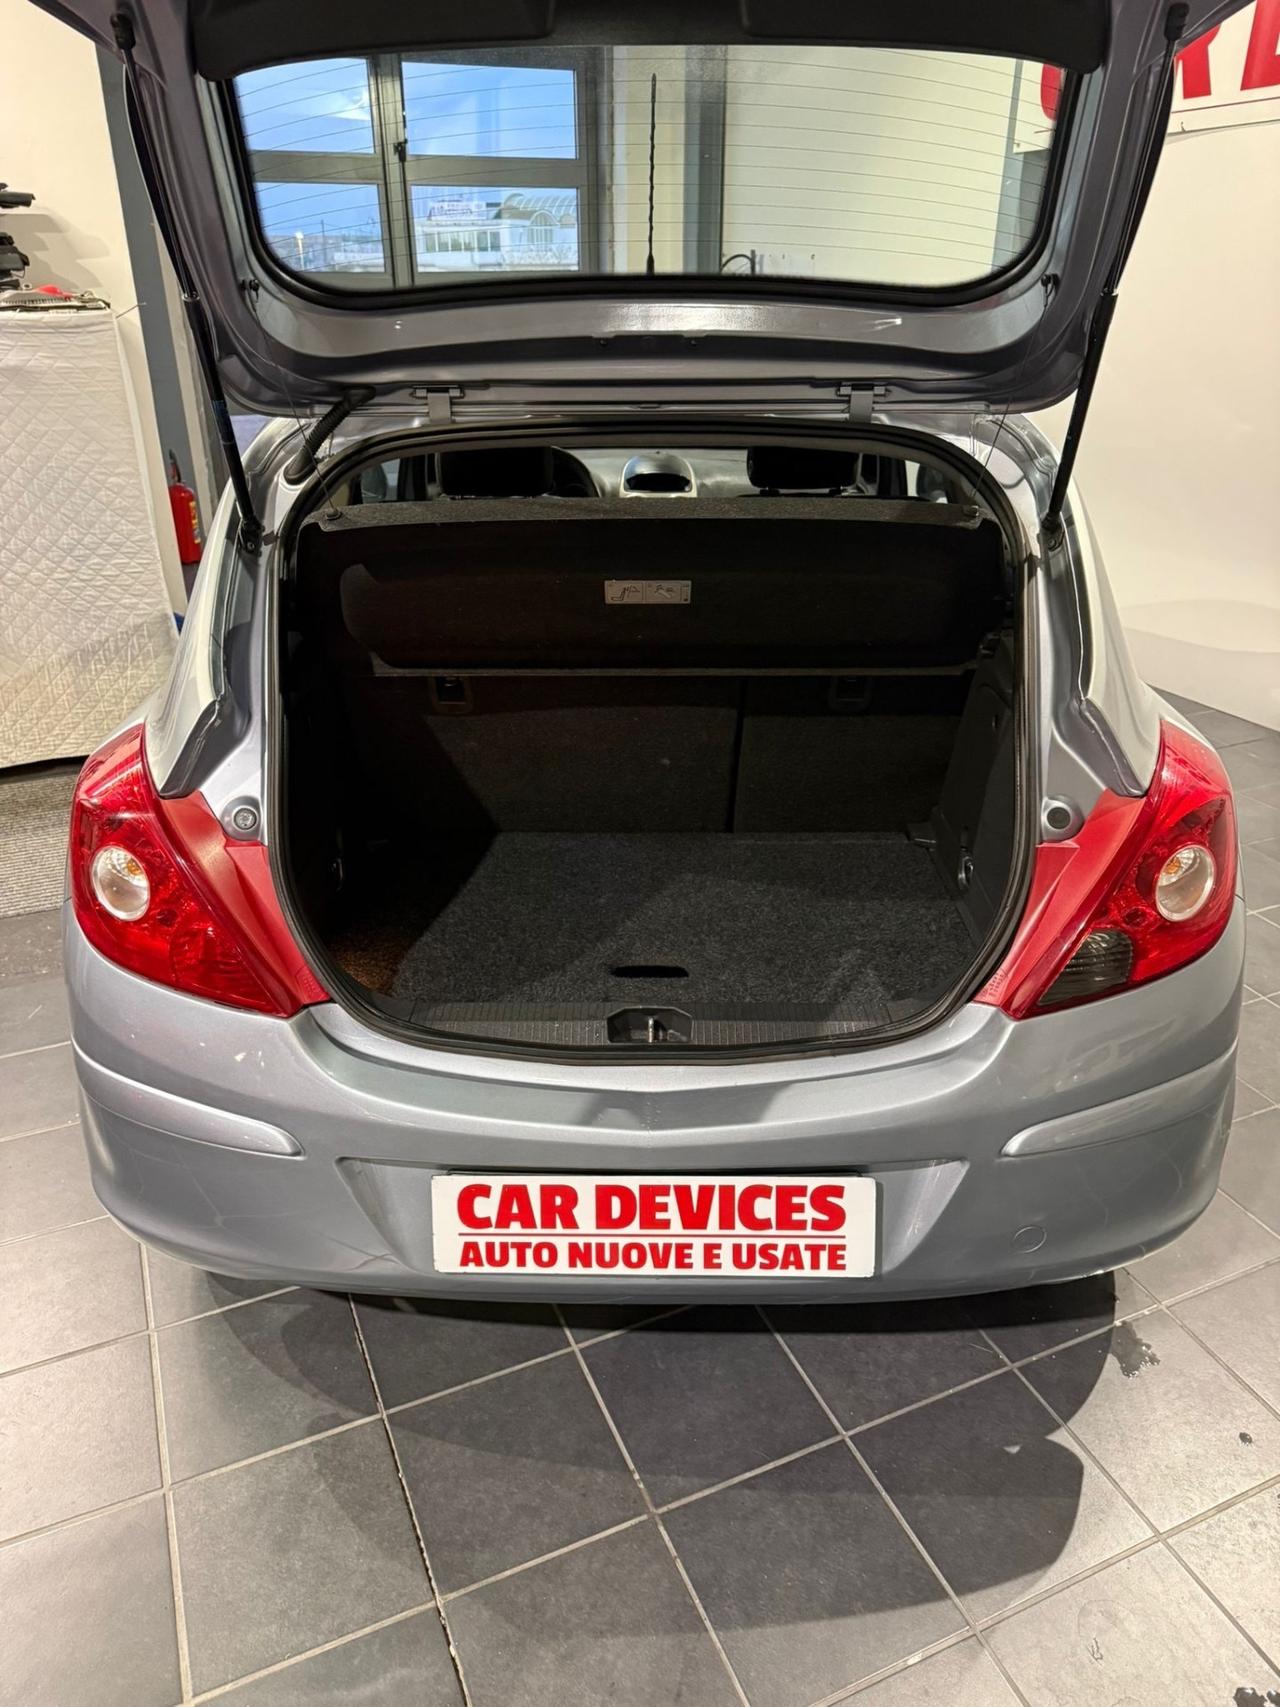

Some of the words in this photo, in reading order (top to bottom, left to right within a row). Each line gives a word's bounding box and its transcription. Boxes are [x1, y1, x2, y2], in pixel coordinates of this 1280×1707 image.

[457, 1183, 579, 1230] CAR
[595, 1183, 846, 1232] DEVICES
[460, 1241, 558, 1268] AUTO
[568, 1241, 693, 1270] NUOVE
[702, 1242, 722, 1270] E
[732, 1242, 846, 1272] USATE
